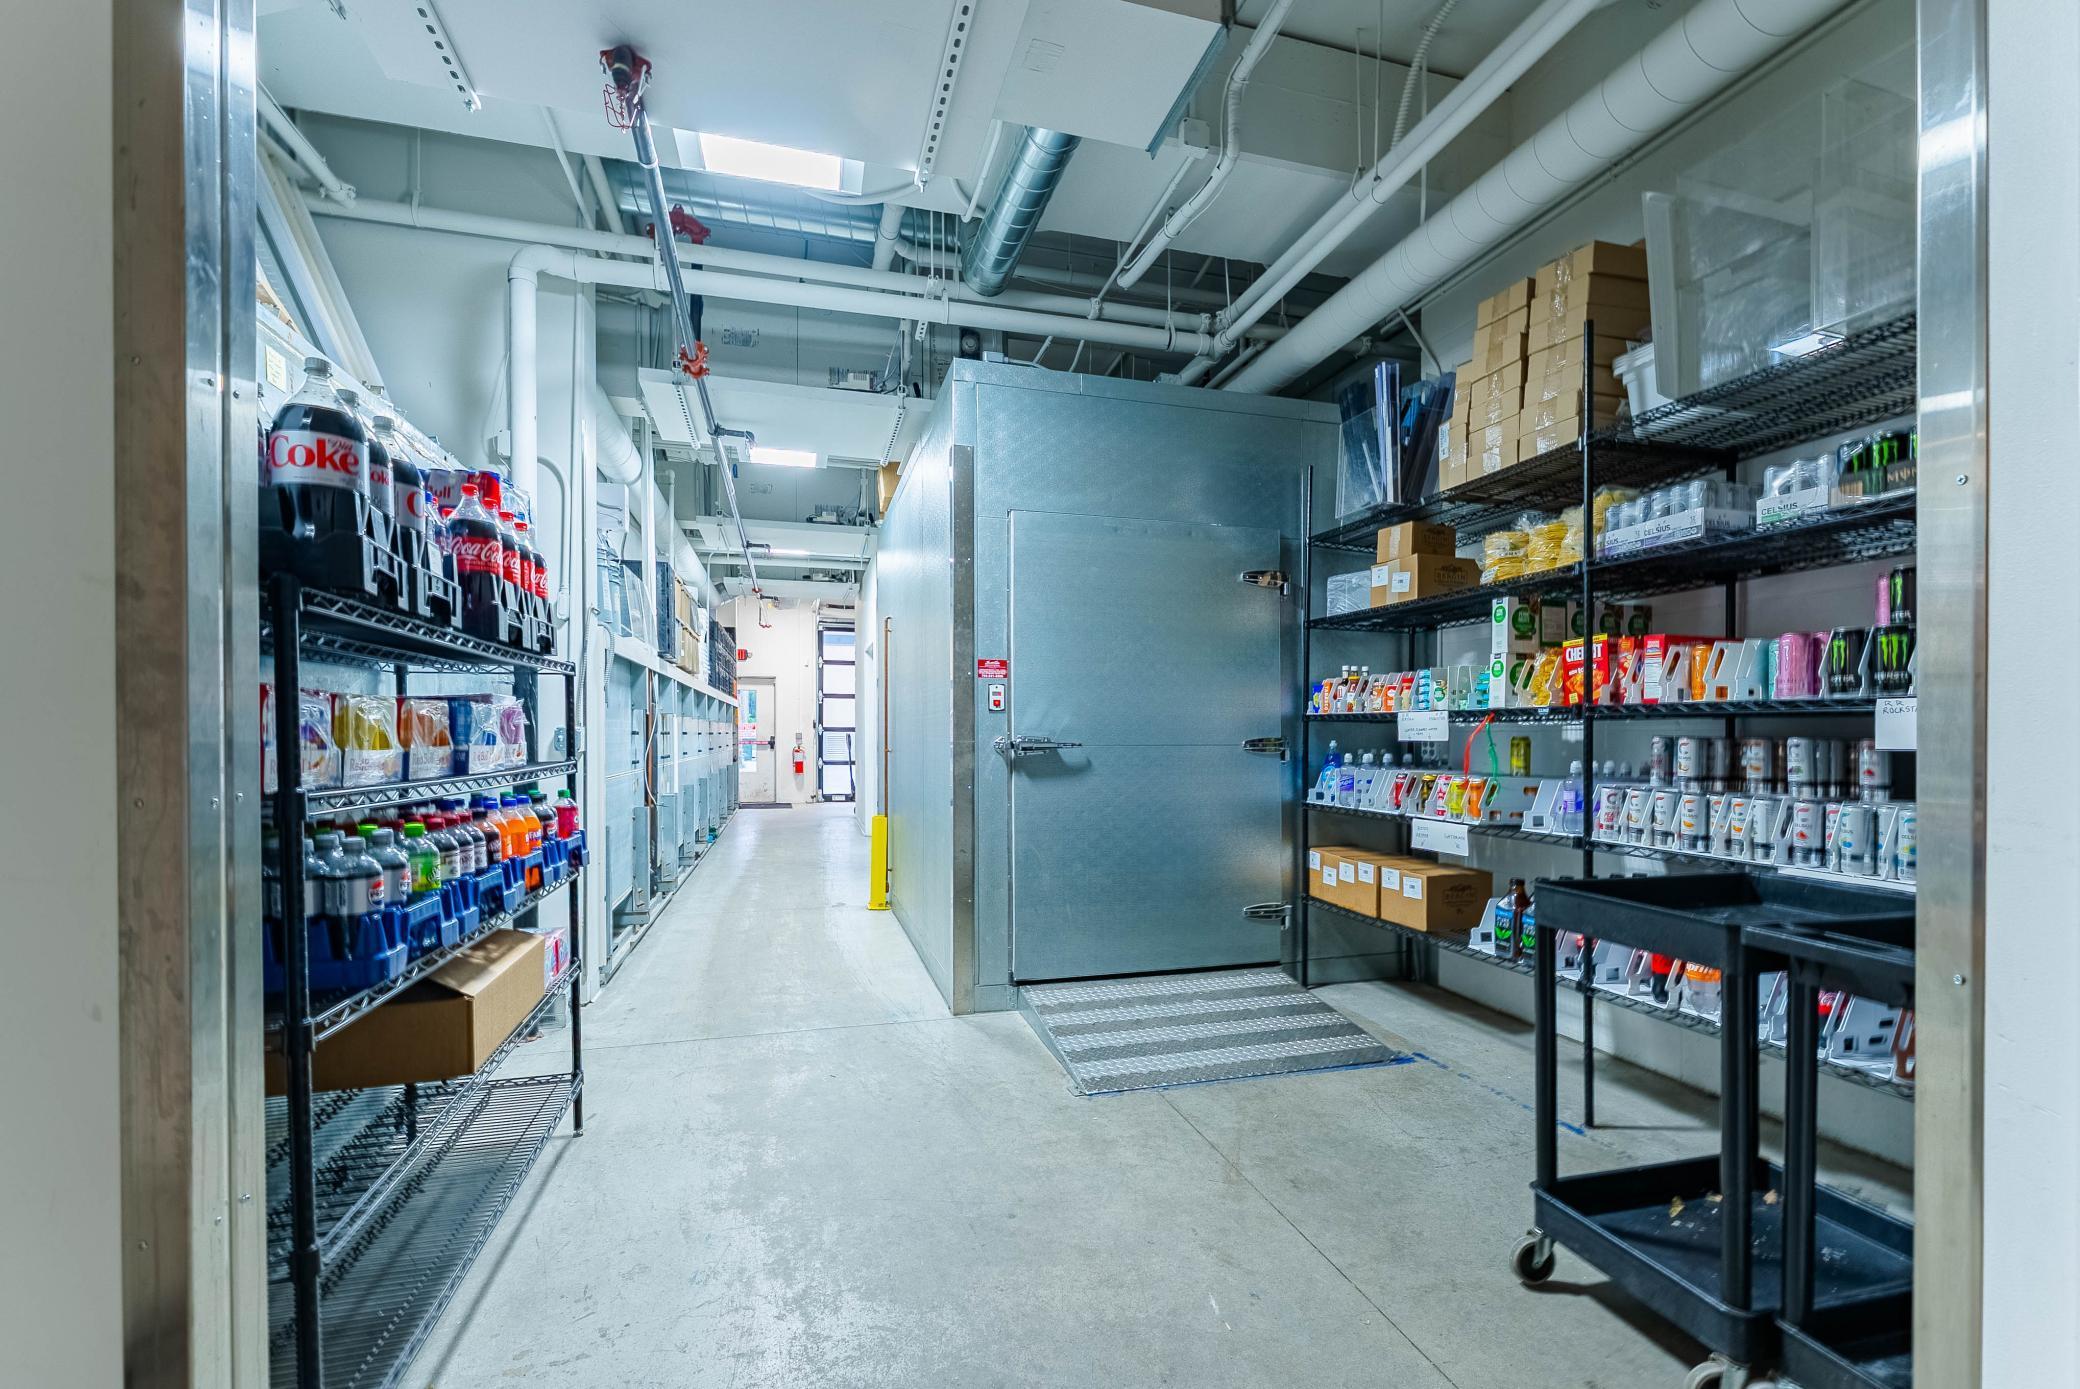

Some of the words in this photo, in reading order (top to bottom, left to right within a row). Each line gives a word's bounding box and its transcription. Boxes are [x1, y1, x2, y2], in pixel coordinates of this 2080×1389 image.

[270, 434, 360, 476] Coke
[1761, 502, 1798, 516] CELSIUS
[1643, 524, 1671, 537] CELSIUS
[1882, 706, 1917, 715] ROCKST
